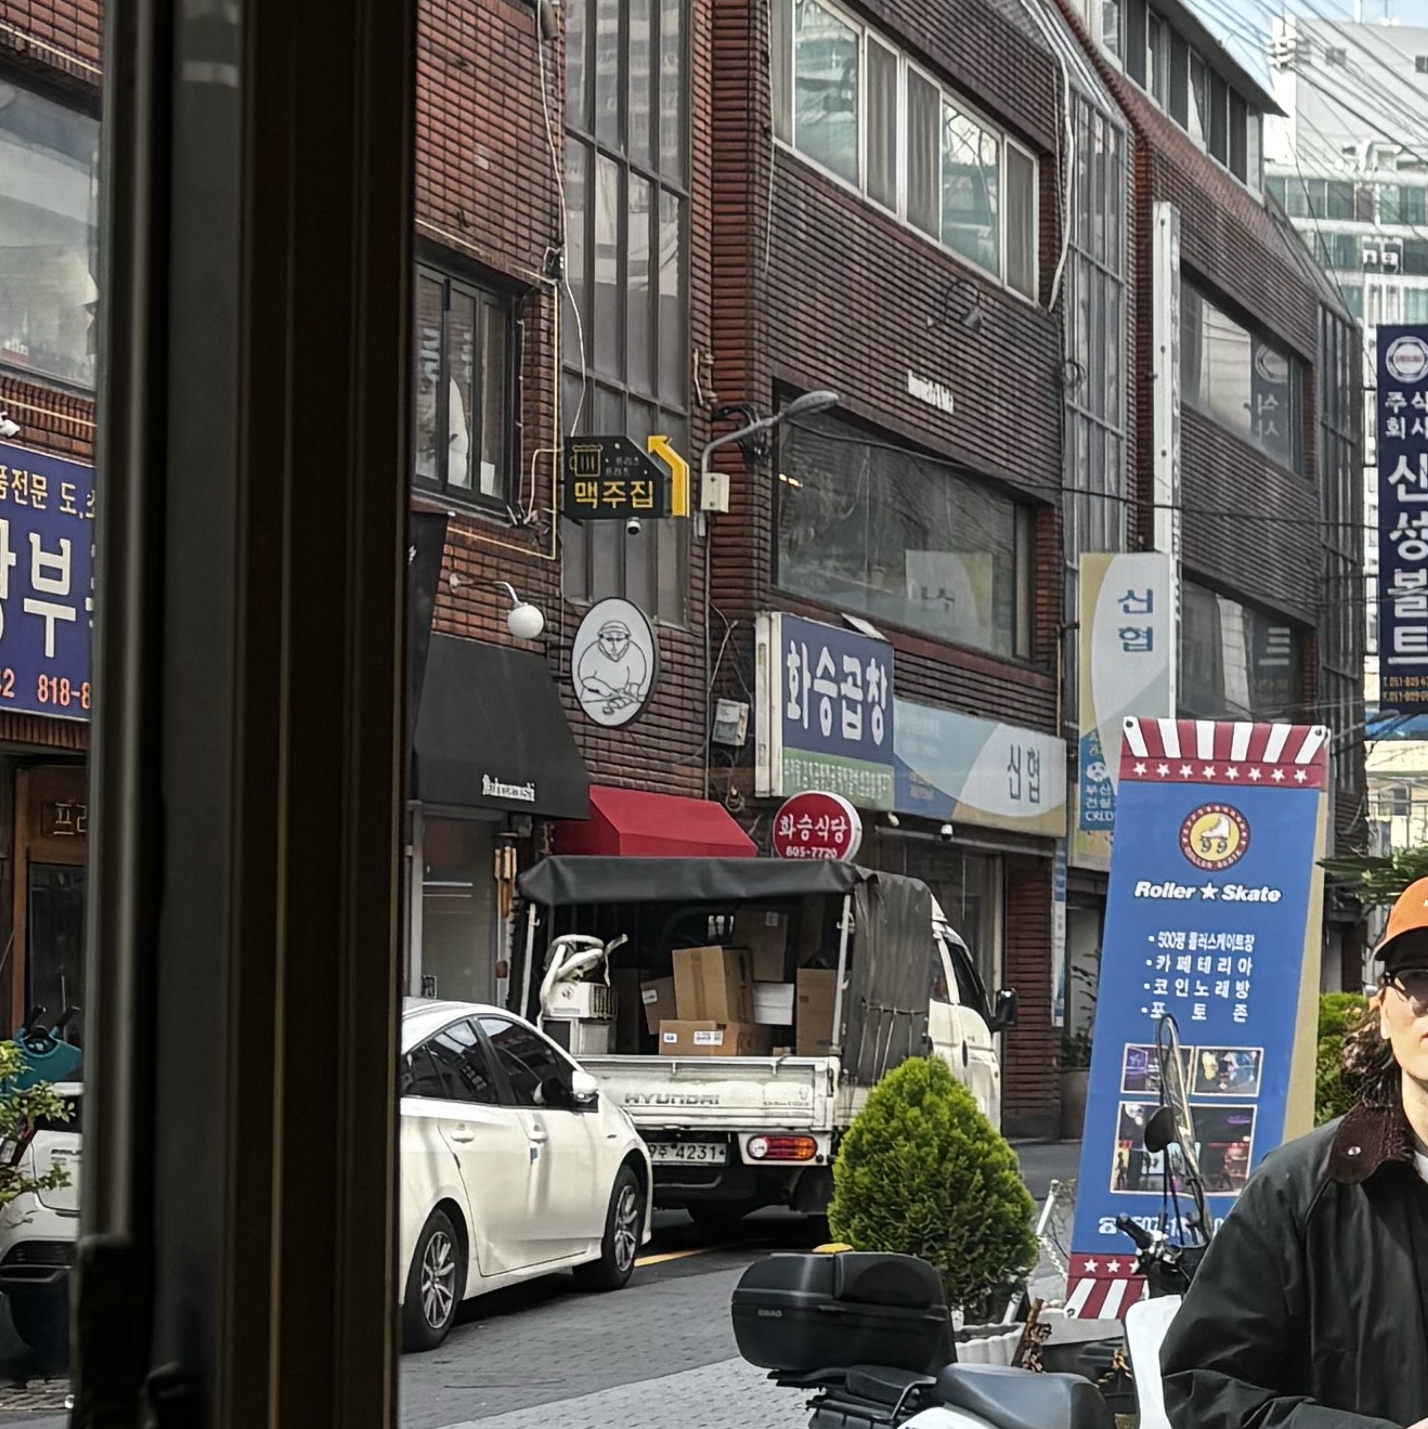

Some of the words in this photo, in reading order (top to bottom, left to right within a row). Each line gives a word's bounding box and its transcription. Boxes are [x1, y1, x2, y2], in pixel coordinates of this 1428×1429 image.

[574, 480, 653, 509] 맥주집
[1117, 587, 1155, 653] 신협
[787, 639, 888, 746] 화승곱창
[1007, 743, 1041, 805] 신협
[778, 813, 848, 844] 화승식당
[1134, 880, 1197, 899] Roller
[1221, 884, 1283, 903] Skate
[1156, 954, 1254, 977] 카페테리아
[1153, 977, 1251, 1000] 코인노래방
[624, 1092, 721, 1106] HYUNDAI
[675, 1145, 717, 1160] 4231
